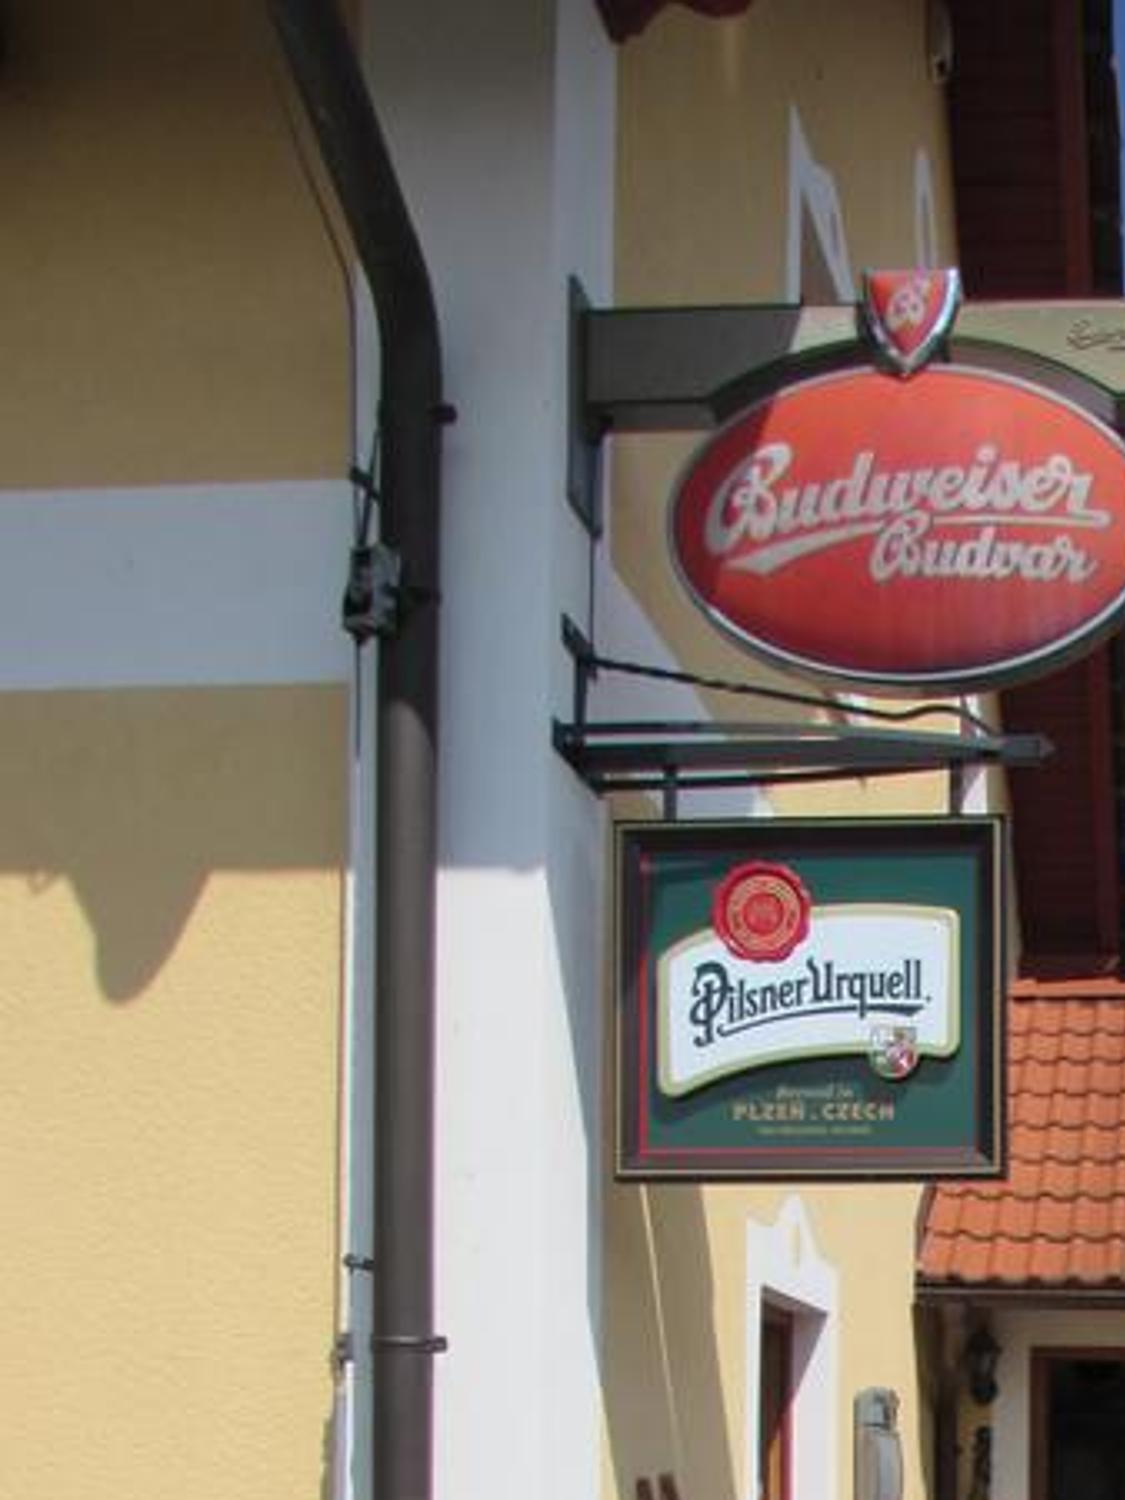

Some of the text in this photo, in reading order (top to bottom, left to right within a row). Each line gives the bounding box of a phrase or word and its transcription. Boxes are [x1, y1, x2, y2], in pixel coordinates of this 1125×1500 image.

[704, 442, 1111, 560] Budweiser
[870, 508, 1096, 583] Budvar
[689, 956, 922, 1047] Pilsner Urquell
